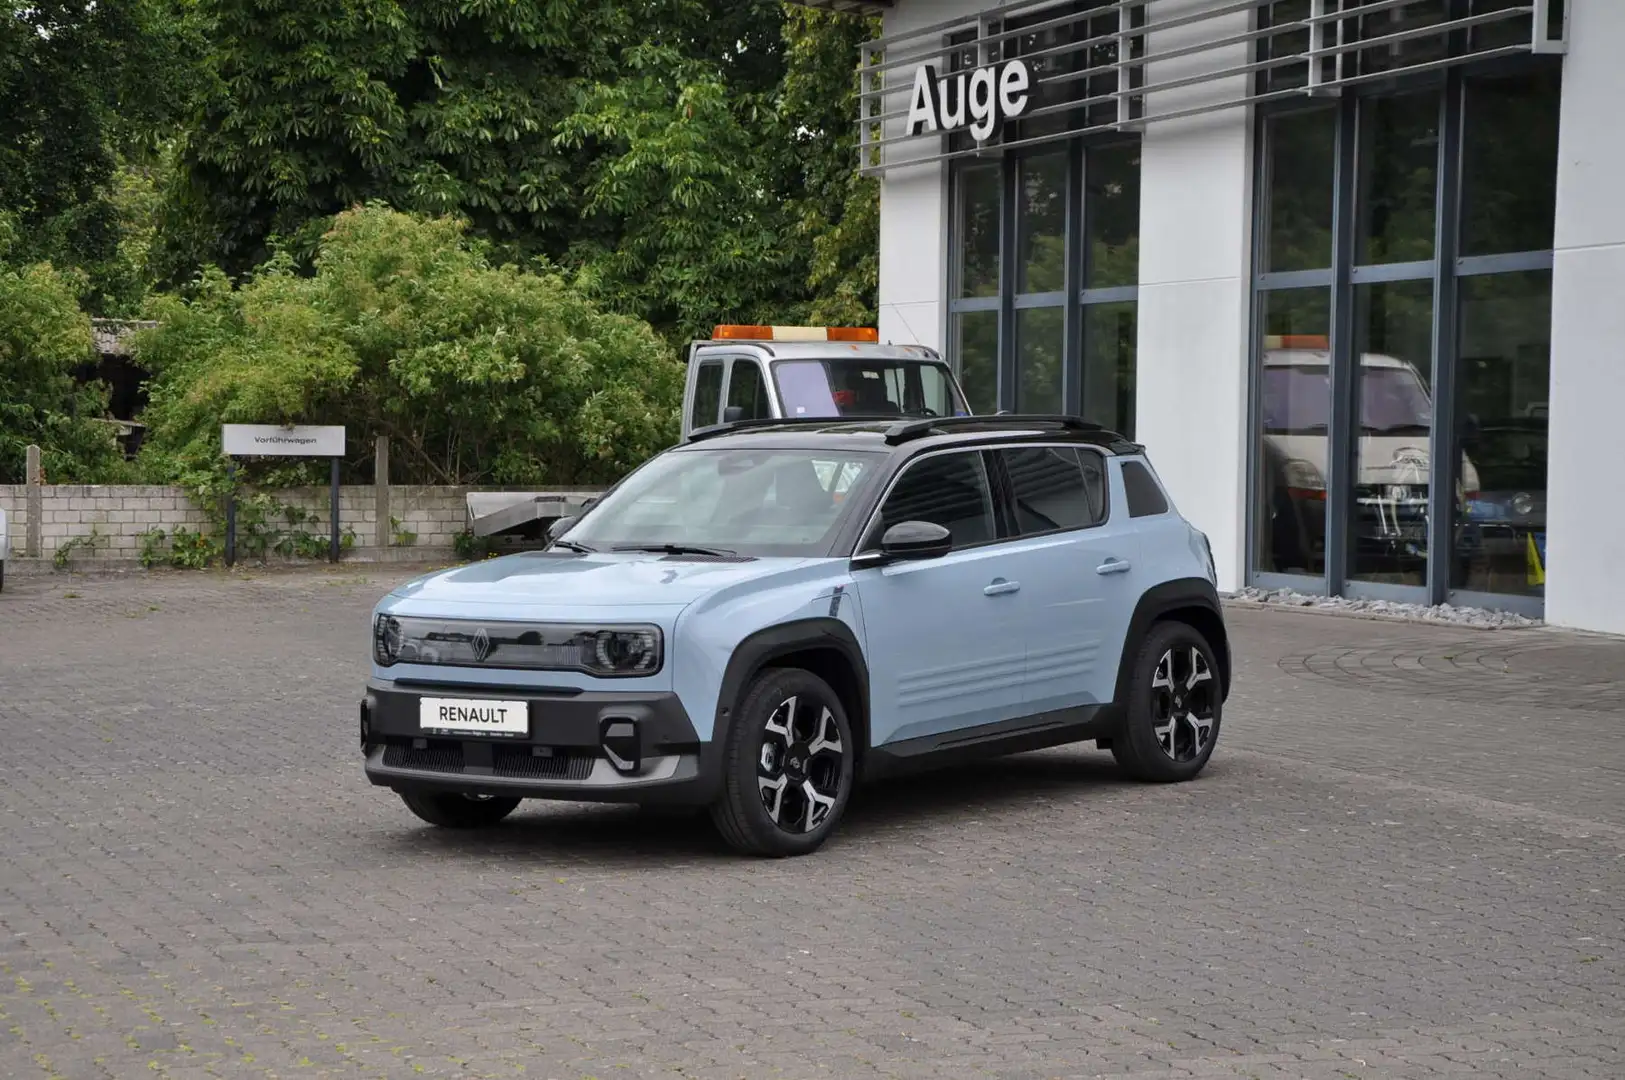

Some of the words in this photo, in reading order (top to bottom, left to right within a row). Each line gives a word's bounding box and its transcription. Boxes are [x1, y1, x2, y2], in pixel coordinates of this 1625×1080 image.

[906, 60, 1029, 140] Auge
[254, 436, 317, 445] Vorführwagen
[439, 706, 508, 724] RENAULT
